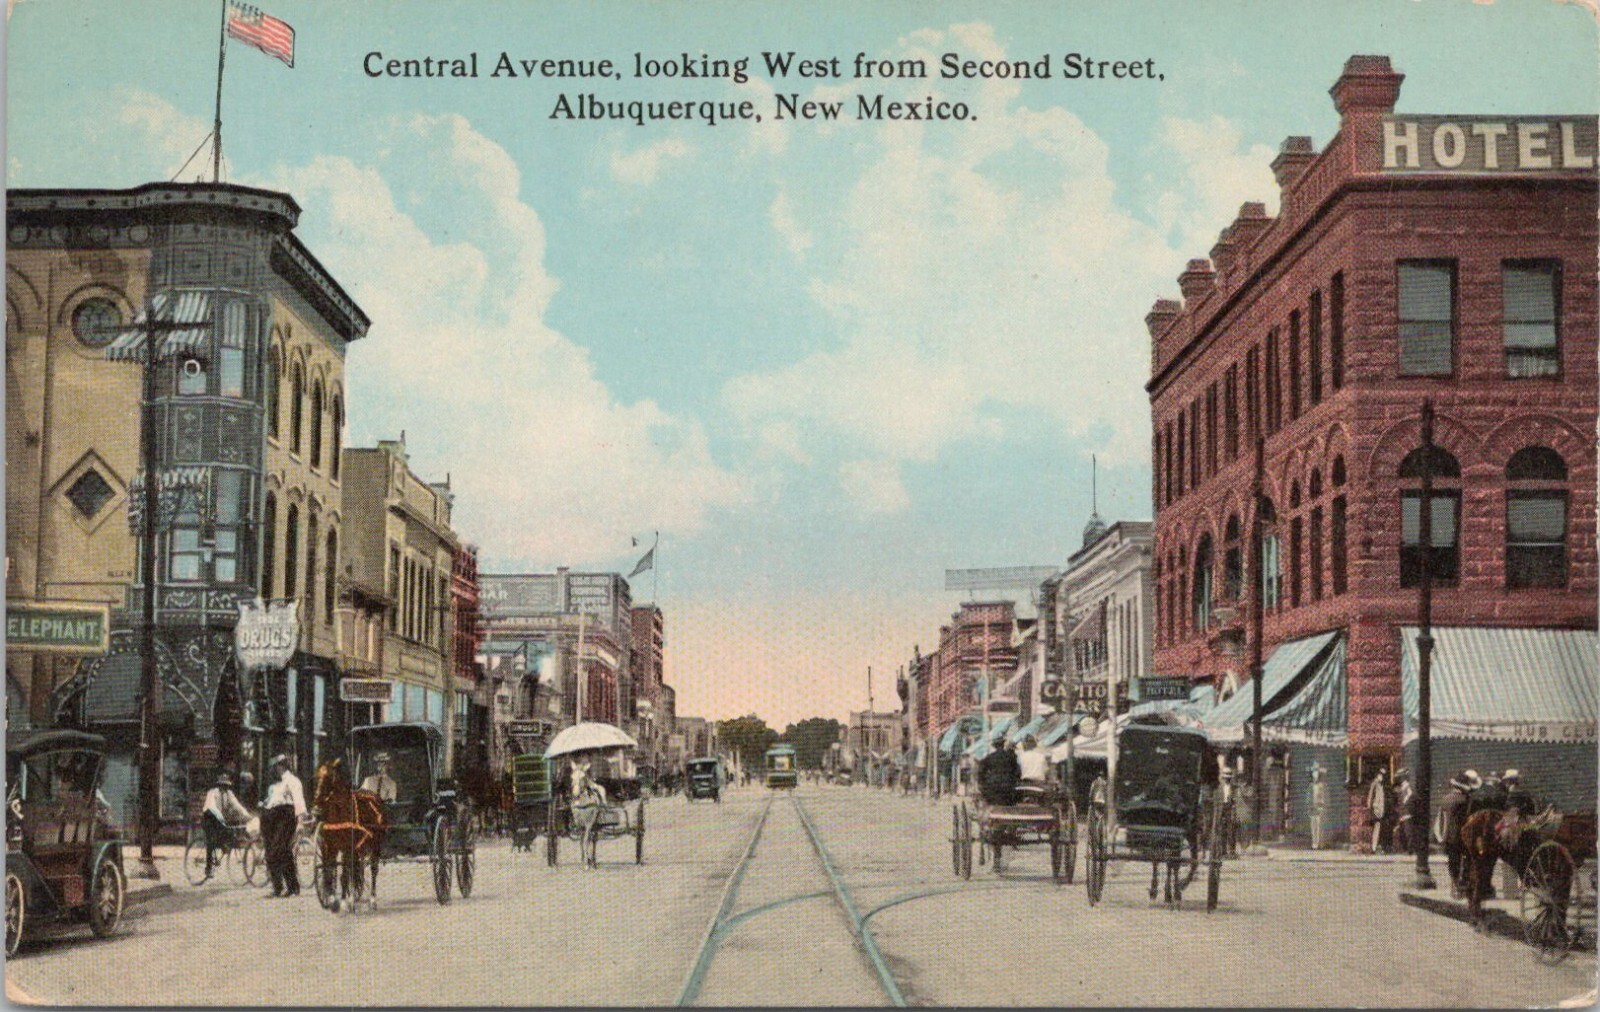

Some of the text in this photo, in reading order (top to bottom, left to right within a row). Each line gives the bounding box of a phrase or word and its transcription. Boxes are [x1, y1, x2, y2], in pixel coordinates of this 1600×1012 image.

[1382, 122, 1594, 168] HOTEL
[239, 626, 293, 650] DRUGS
[1513, 723, 1548, 737] HUB
